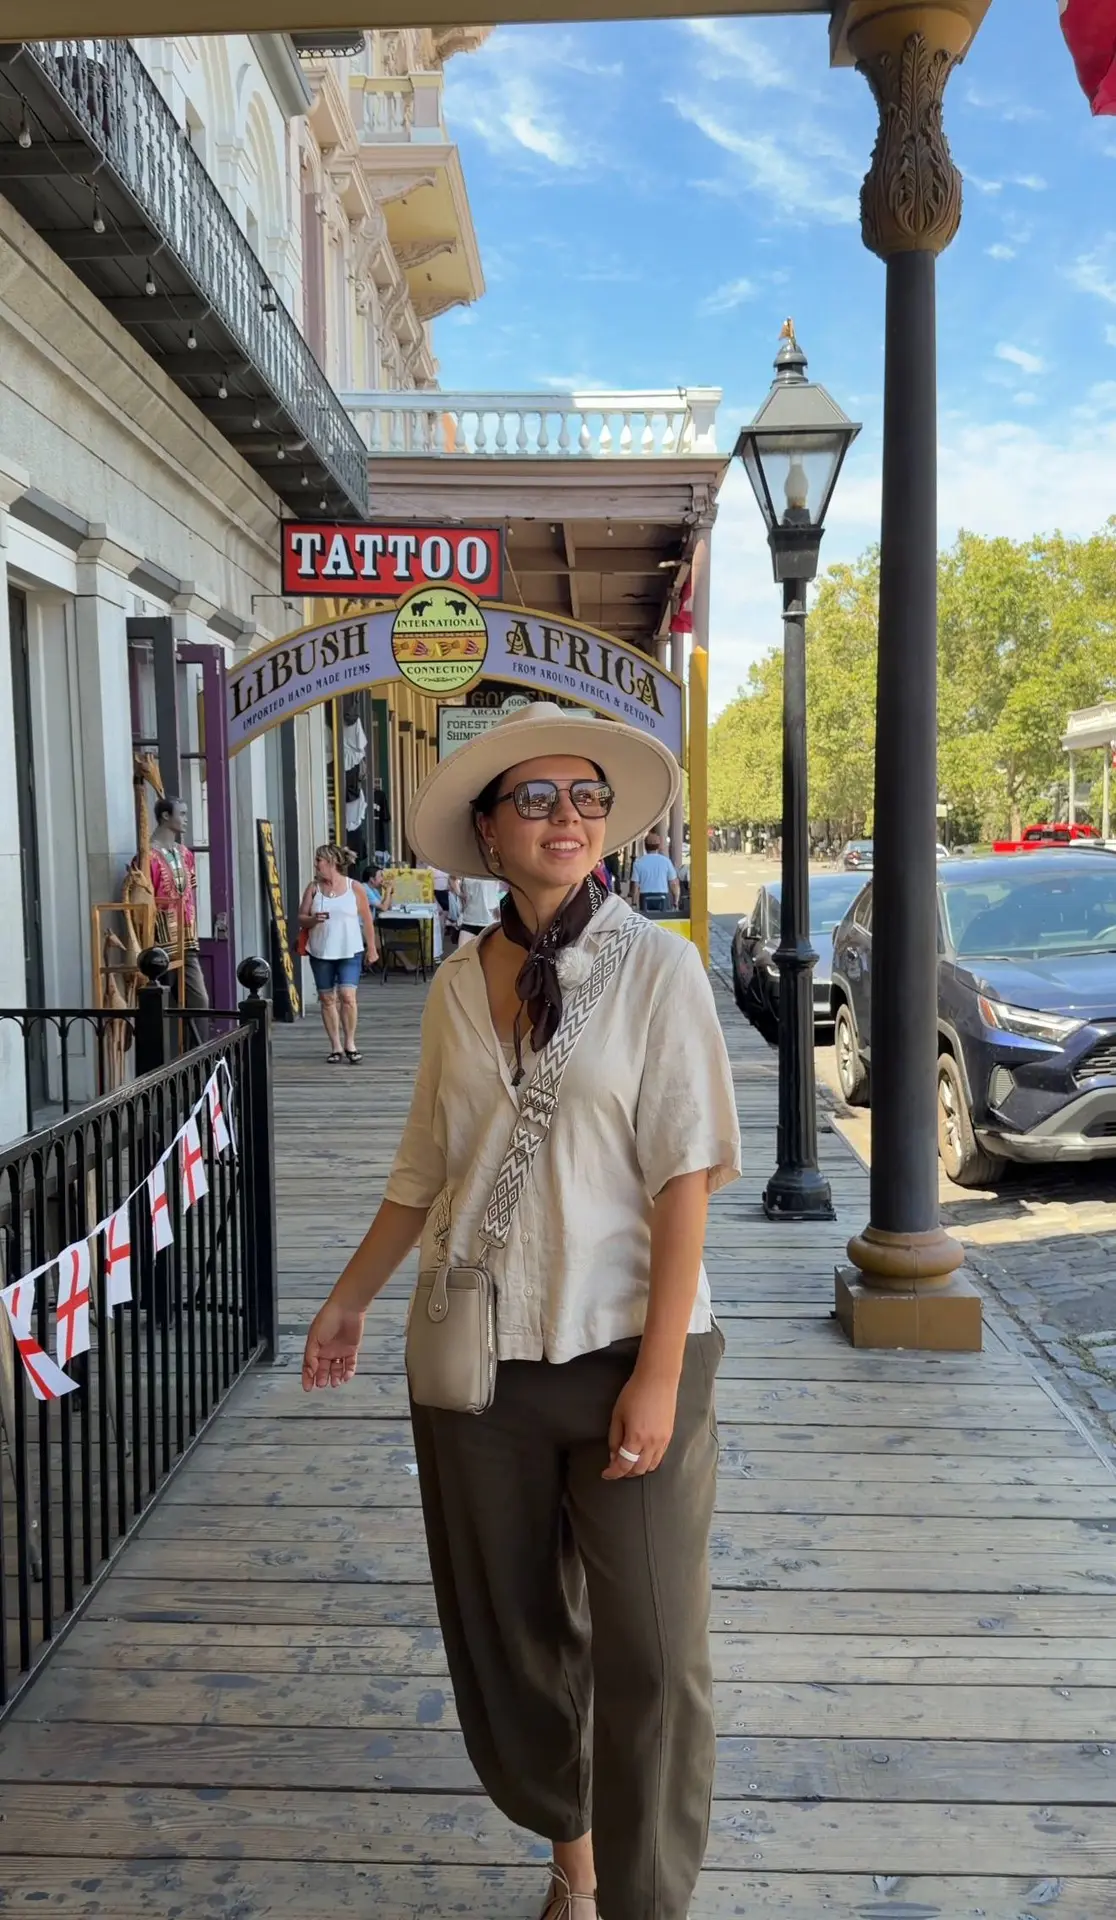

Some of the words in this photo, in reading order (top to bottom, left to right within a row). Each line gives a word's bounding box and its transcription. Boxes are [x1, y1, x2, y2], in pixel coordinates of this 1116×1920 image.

[291, 533, 491, 583] TATTOO
[397, 618, 481, 628] INTERNATIONAL
[230, 622, 369, 721] LIBUSH
[505, 620, 664, 717] AFRICA
[406, 665, 474, 675] CONNECTION
[242, 697, 285, 731] IMPORTED
[288, 683, 312, 702] HAND
[316, 672, 340, 690] MADE
[344, 663, 371, 679] ITEMS
[512, 661, 536, 676] FROM
[540, 668, 576, 688] AROUND
[579, 682, 610, 703] AFRICA
[613, 699, 620, 708] &
[624, 702, 656, 729] BEYOND
[446, 720, 488, 729] FOREST
